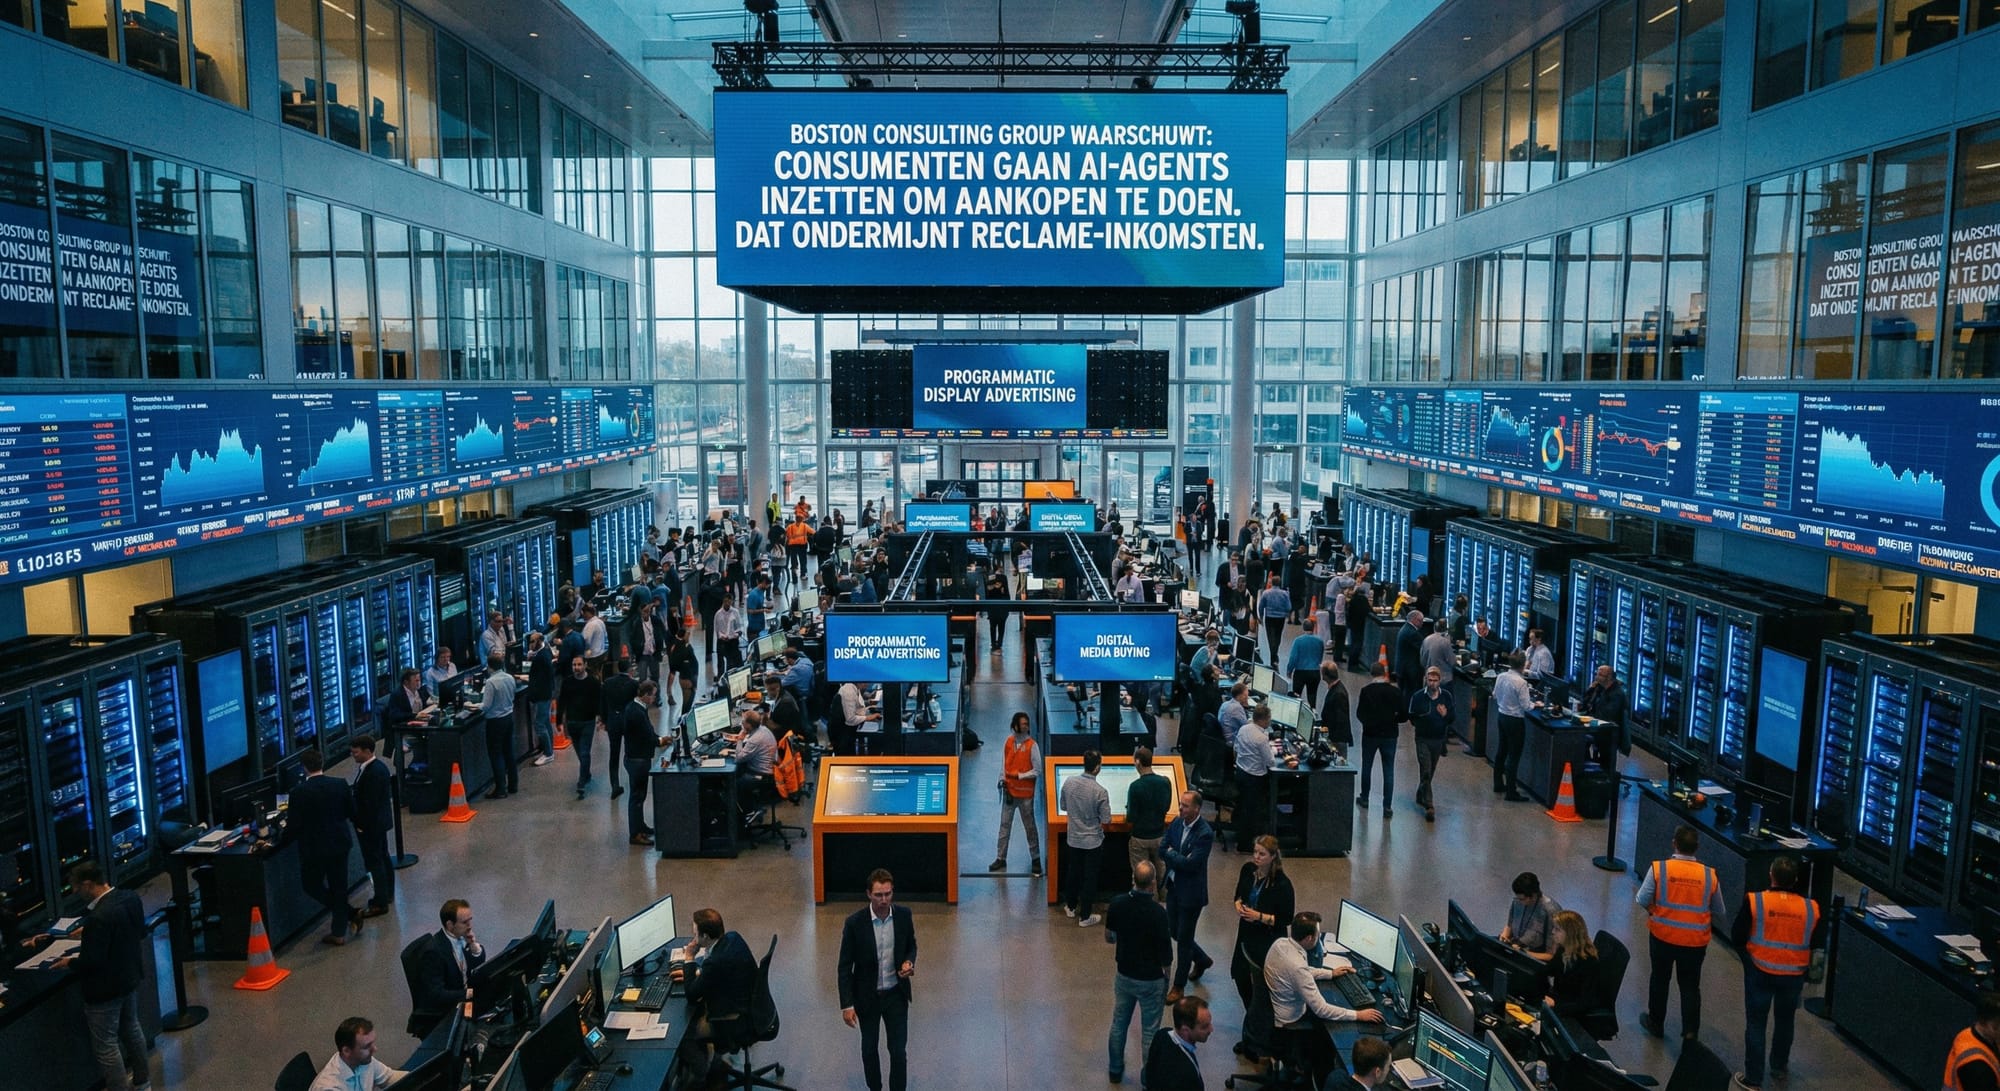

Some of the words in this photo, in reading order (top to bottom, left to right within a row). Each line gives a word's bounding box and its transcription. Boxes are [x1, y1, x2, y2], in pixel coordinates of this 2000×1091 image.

[790, 123, 867, 145] BOSTON
[873, 123, 994, 145] CONSULTING
[998, 124, 1066, 145] GROUP
[1070, 124, 1213, 146] WAARSCHUWT:
[774, 150, 985, 181] CONSUMENTEN
[993, 151, 1071, 181] GAAN
[1079, 151, 1229, 182] AI-AGENTS
[761, 186, 895, 215] INZETTEN
[903, 186, 946, 215] OM
[954, 186, 1107, 216] AANKOPEN
[1115, 187, 1150, 216] TE
[1158, 187, 1241, 217] DOEN.
[37, 228, 92, 250] COSULTING
[93, 239, 121, 254] GROUP
[735, 220, 785, 248] DAT
[792, 220, 965, 249] ONDERMIJNT
[971, 221, 1265, 250] RECLAME-INKOMSTEN.
[1918, 233, 1944, 249] GROU
[89, 254, 121, 274] GAAN
[123, 259, 178, 281] AIAGENTS
[1870, 276, 1889, 293] OM
[1890, 264, 1959, 293] AANKOPN
[1961, 265, 1979, 284] TE
[0, 261, 52, 284] ZETTEN
[75, 271, 135, 293] AANKOPEN
[140, 279, 153, 295] TE
[153, 281, 183, 299] DOEN.
[0, 283, 79, 306] ONDERMNT
[1809, 301, 1829, 318] DAT
[1830, 295, 1898, 316] ONDEMIJNT
[943, 369, 1056, 385] PROGRAMMATIC
[923, 387, 981, 403] DISPLAY
[984, 387, 1076, 403] ADVERTISING
[847, 635, 926, 648] PROGRAMMATIC
[1096, 634, 1135, 647] DIGITAL
[834, 647, 875, 660] DISPLAY
[876, 647, 941, 660] ADVERTISING
[1079, 646, 1112, 659] MEDIA
[1113, 646, 1151, 659] BUYING
